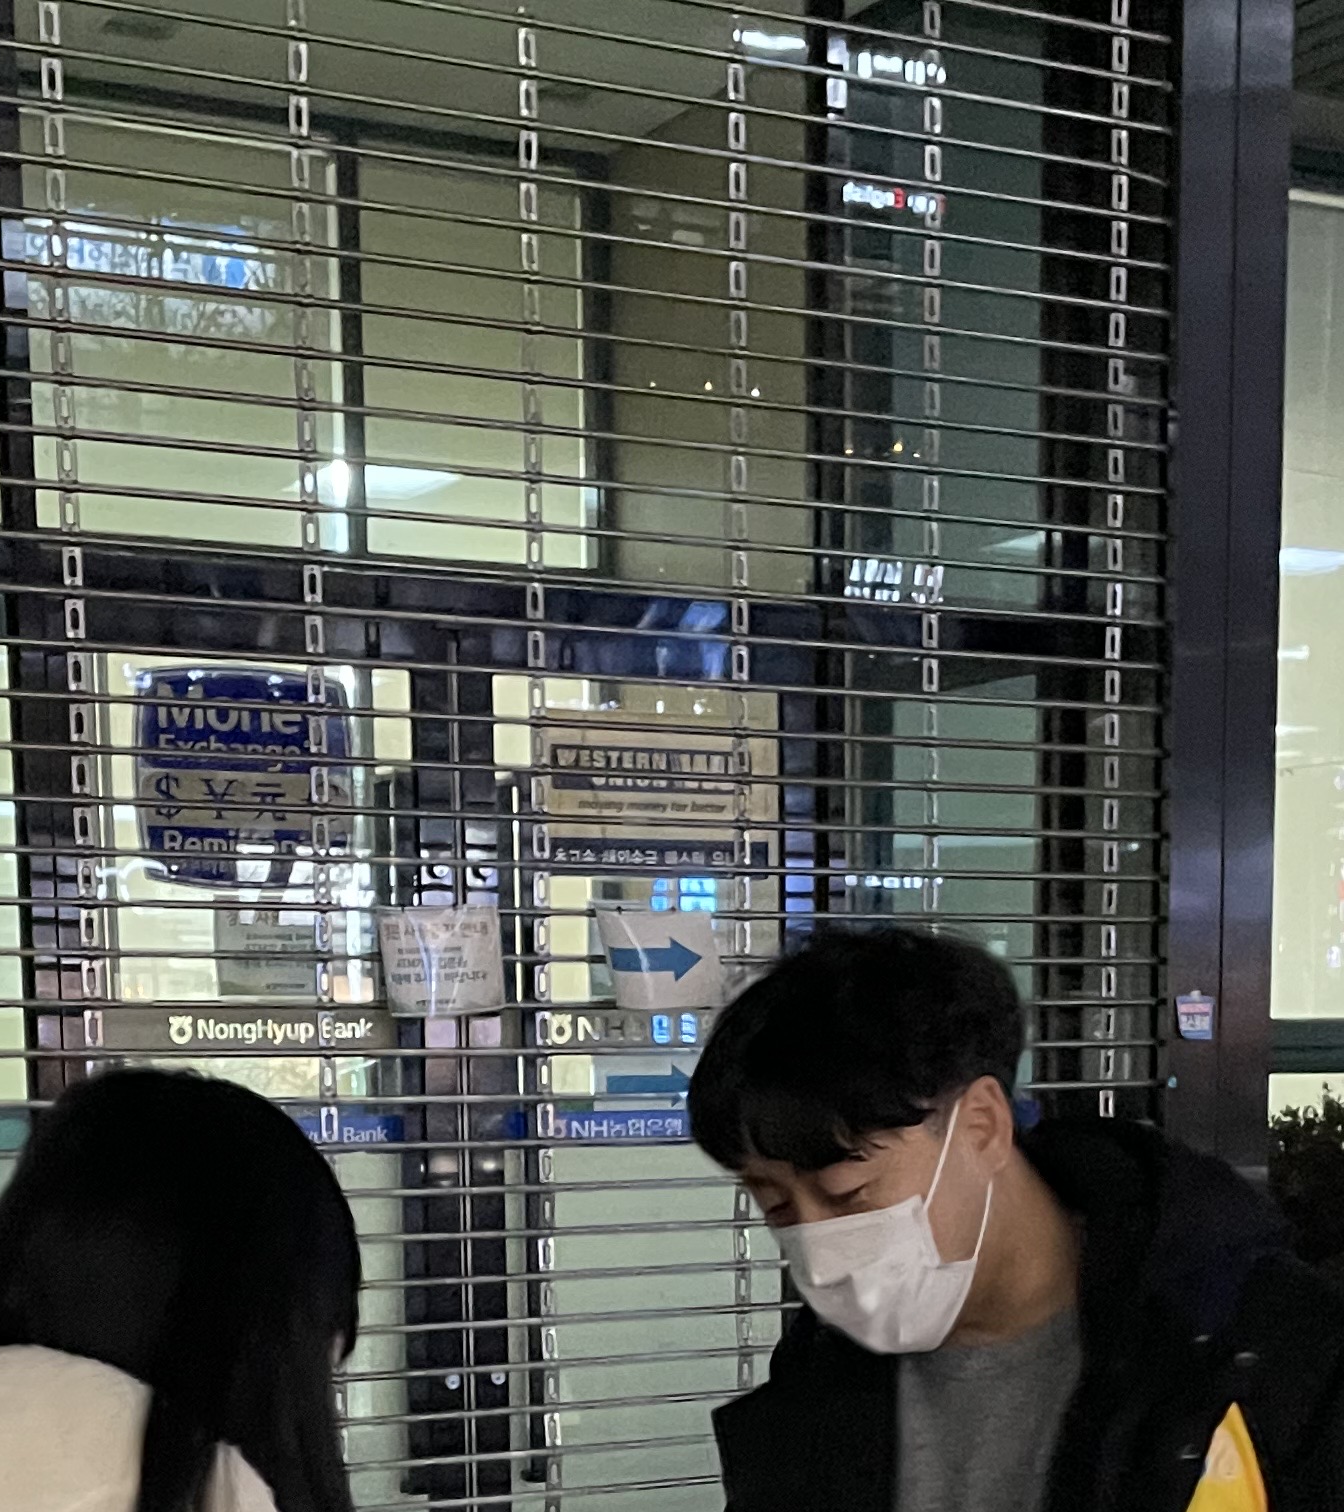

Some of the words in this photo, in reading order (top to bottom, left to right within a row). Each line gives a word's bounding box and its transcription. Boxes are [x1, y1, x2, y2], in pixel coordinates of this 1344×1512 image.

[156, 682, 322, 736] Mone
[555, 747, 668, 771] WESTERN
[197, 1017, 315, 1046] NongHyup
[342, 1125, 388, 1144] Bank
